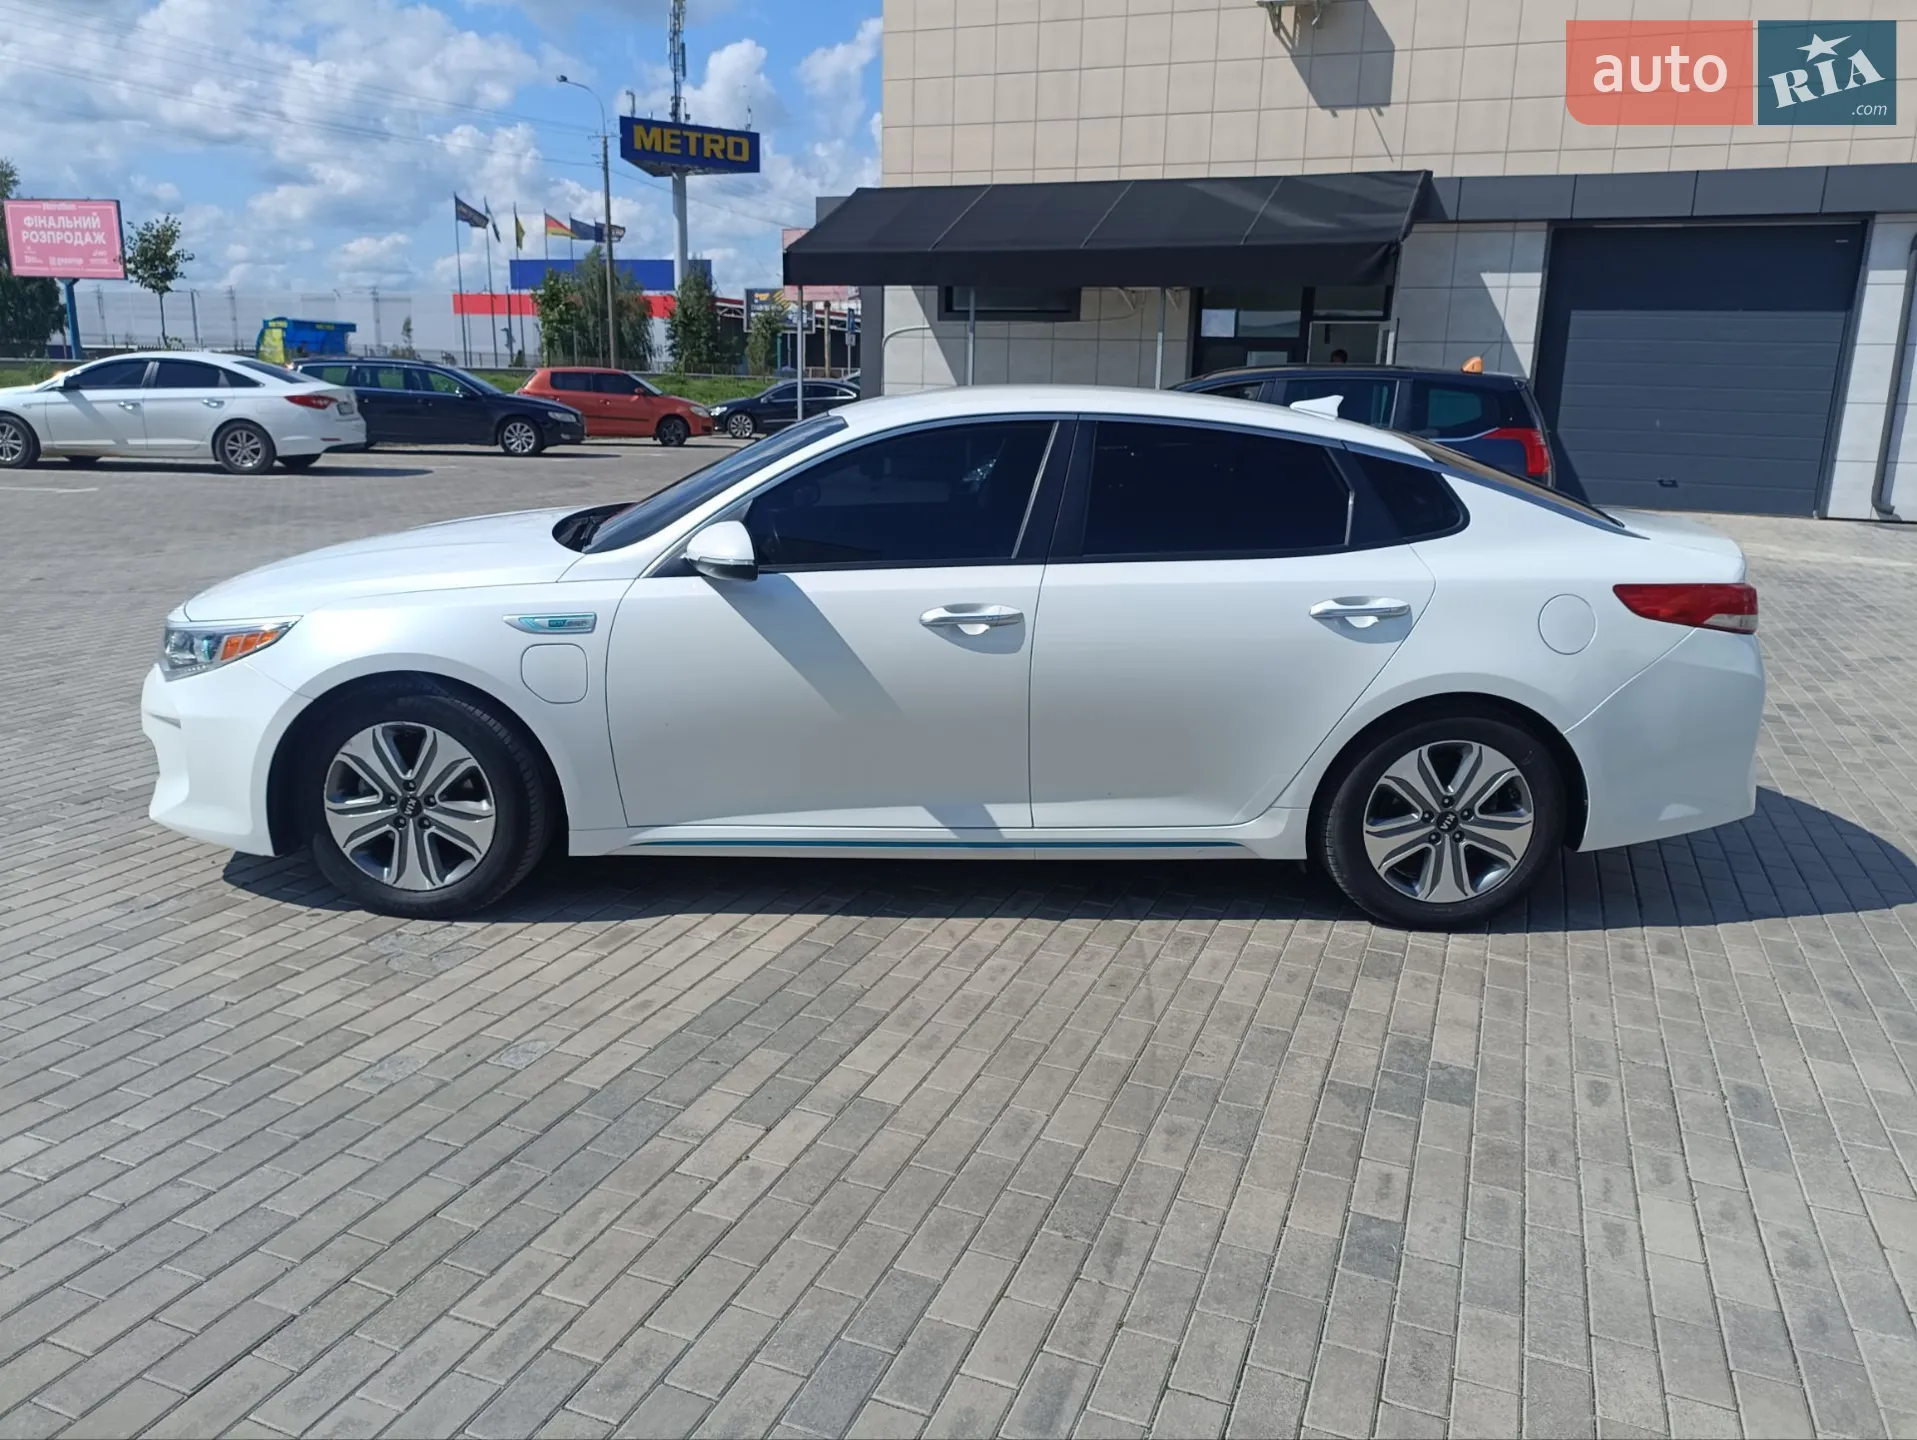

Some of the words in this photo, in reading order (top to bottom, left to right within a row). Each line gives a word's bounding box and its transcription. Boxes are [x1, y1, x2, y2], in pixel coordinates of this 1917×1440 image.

[633, 124, 750, 162] METRO
[23, 212, 100, 229] ФІНАЛЬНИЙ
[22, 230, 106, 246] РОЗПРОДАЖ
[1440, 814, 1455, 830] KIA
